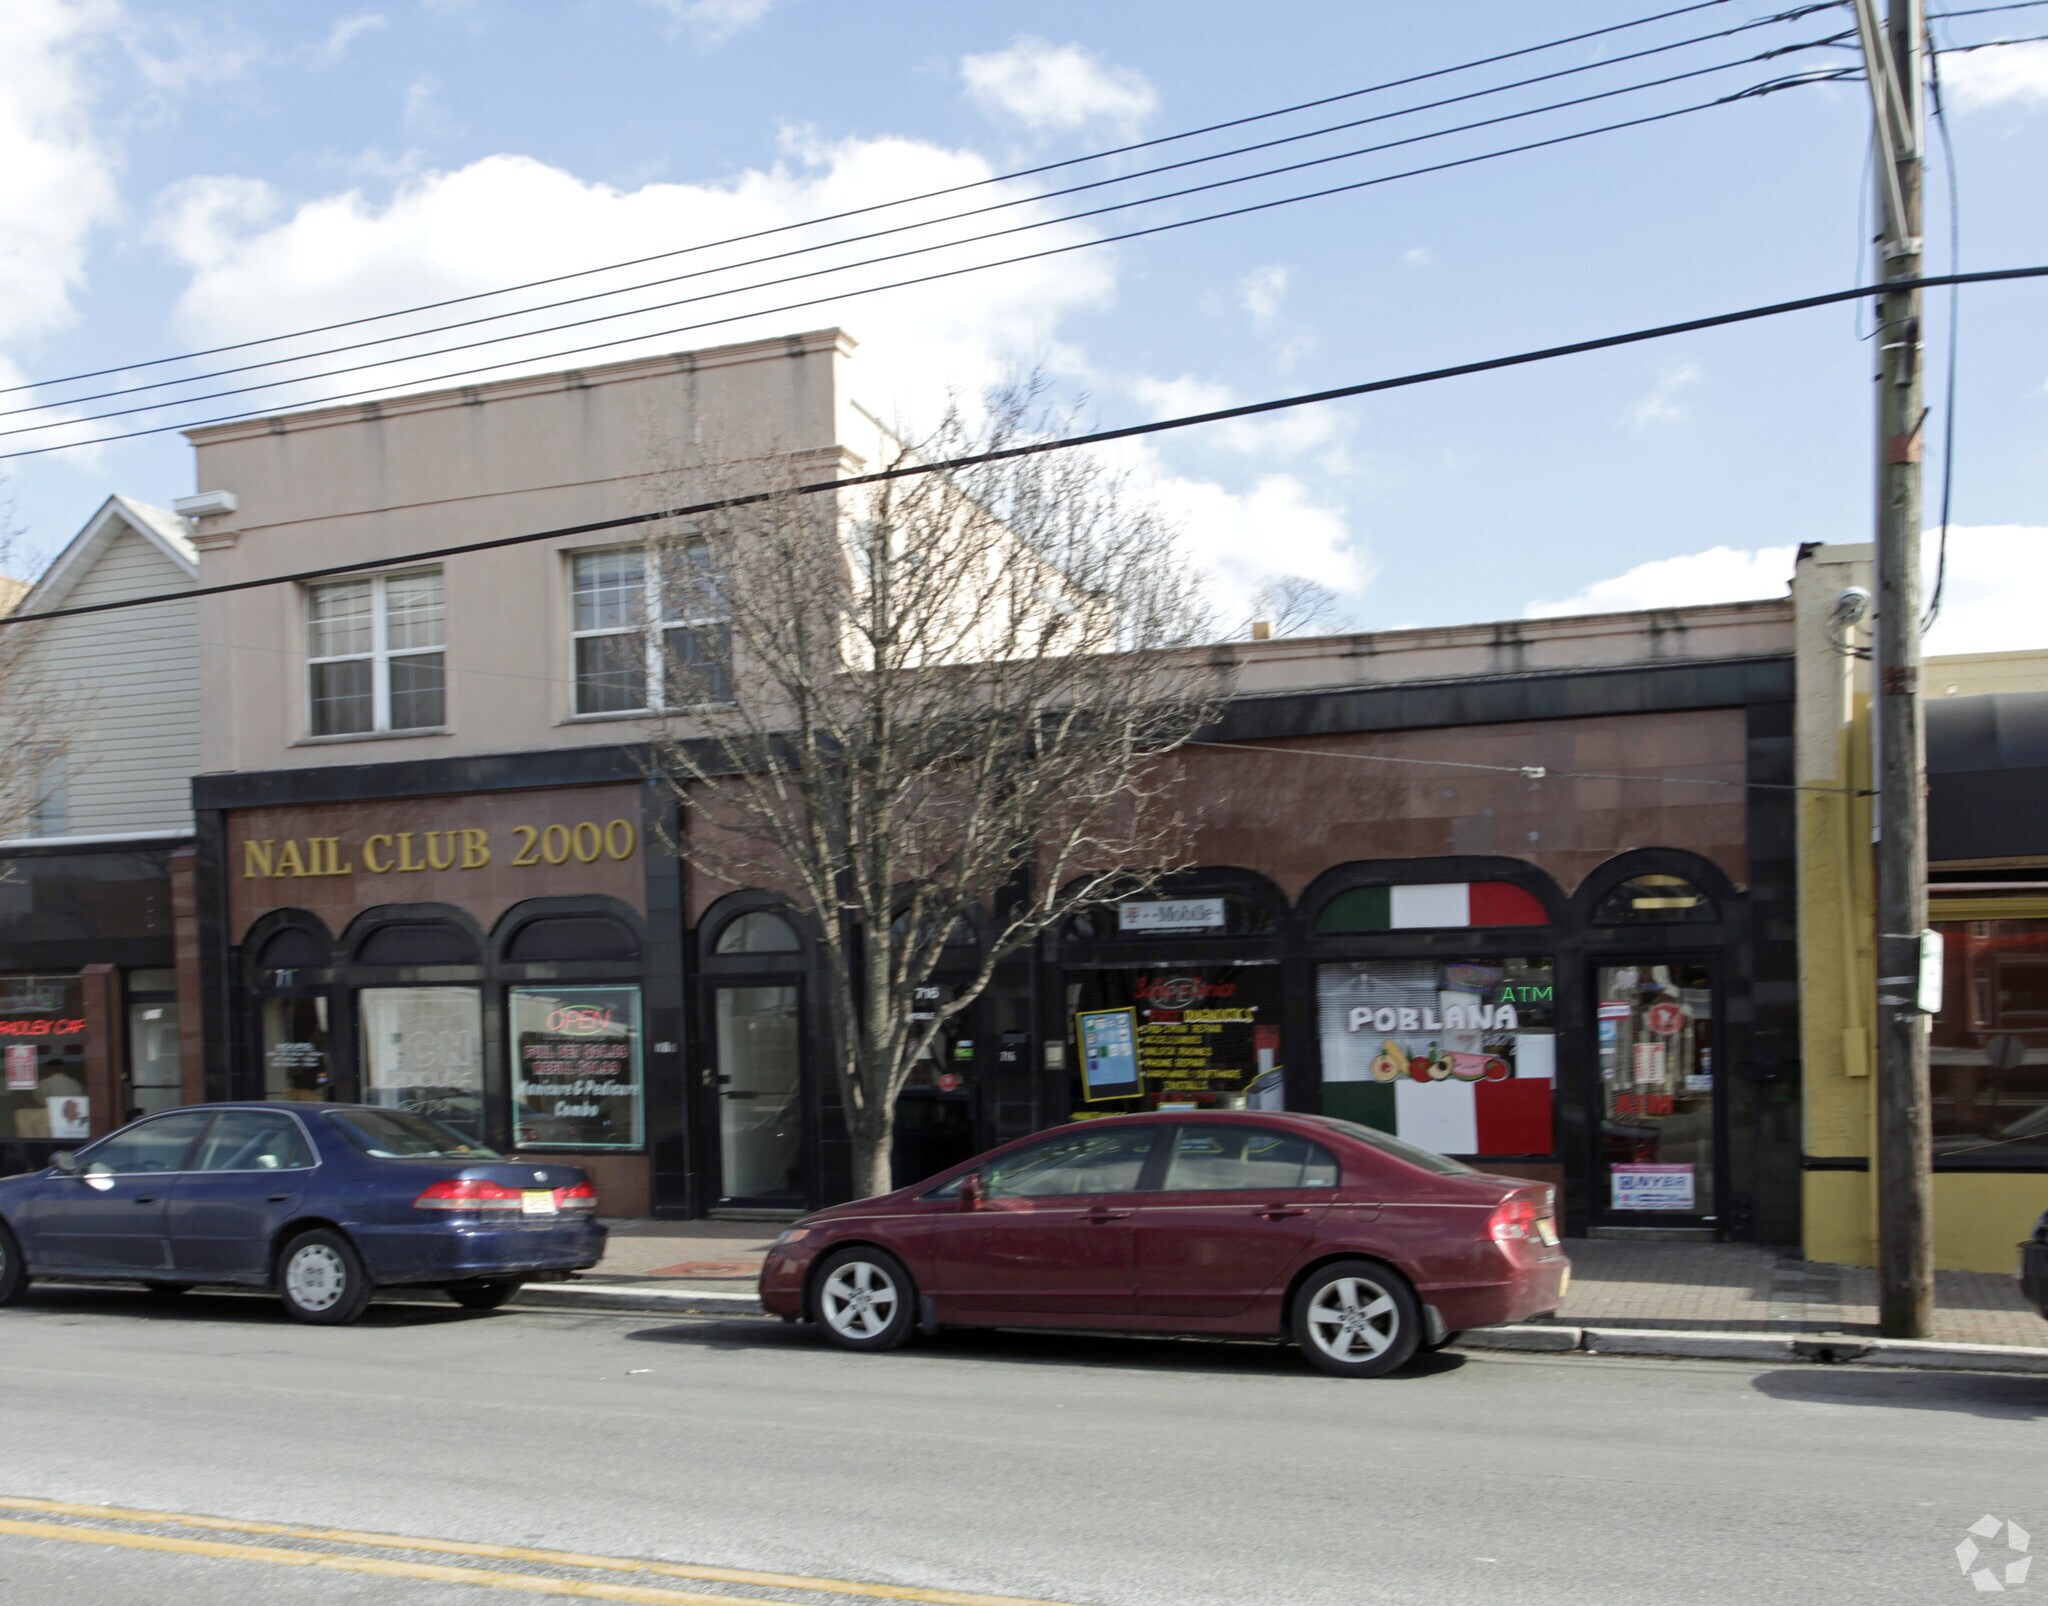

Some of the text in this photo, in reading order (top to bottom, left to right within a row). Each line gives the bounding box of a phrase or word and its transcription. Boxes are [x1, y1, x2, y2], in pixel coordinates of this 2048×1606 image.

[242, 818, 635, 878] NAIL CLUB 2000
[914, 986, 941, 999] 716
[1500, 985, 1553, 1002] ATM
[546, 1008, 612, 1031] OPEN
[1348, 1003, 1520, 1033] POBLANA
[557, 1044, 582, 1059] SET
[516, 1078, 574, 1096] Manicure
[584, 1079, 641, 1096] Pedicure
[554, 1100, 600, 1117] Combo
[1615, 1094, 1675, 1114] ATM
